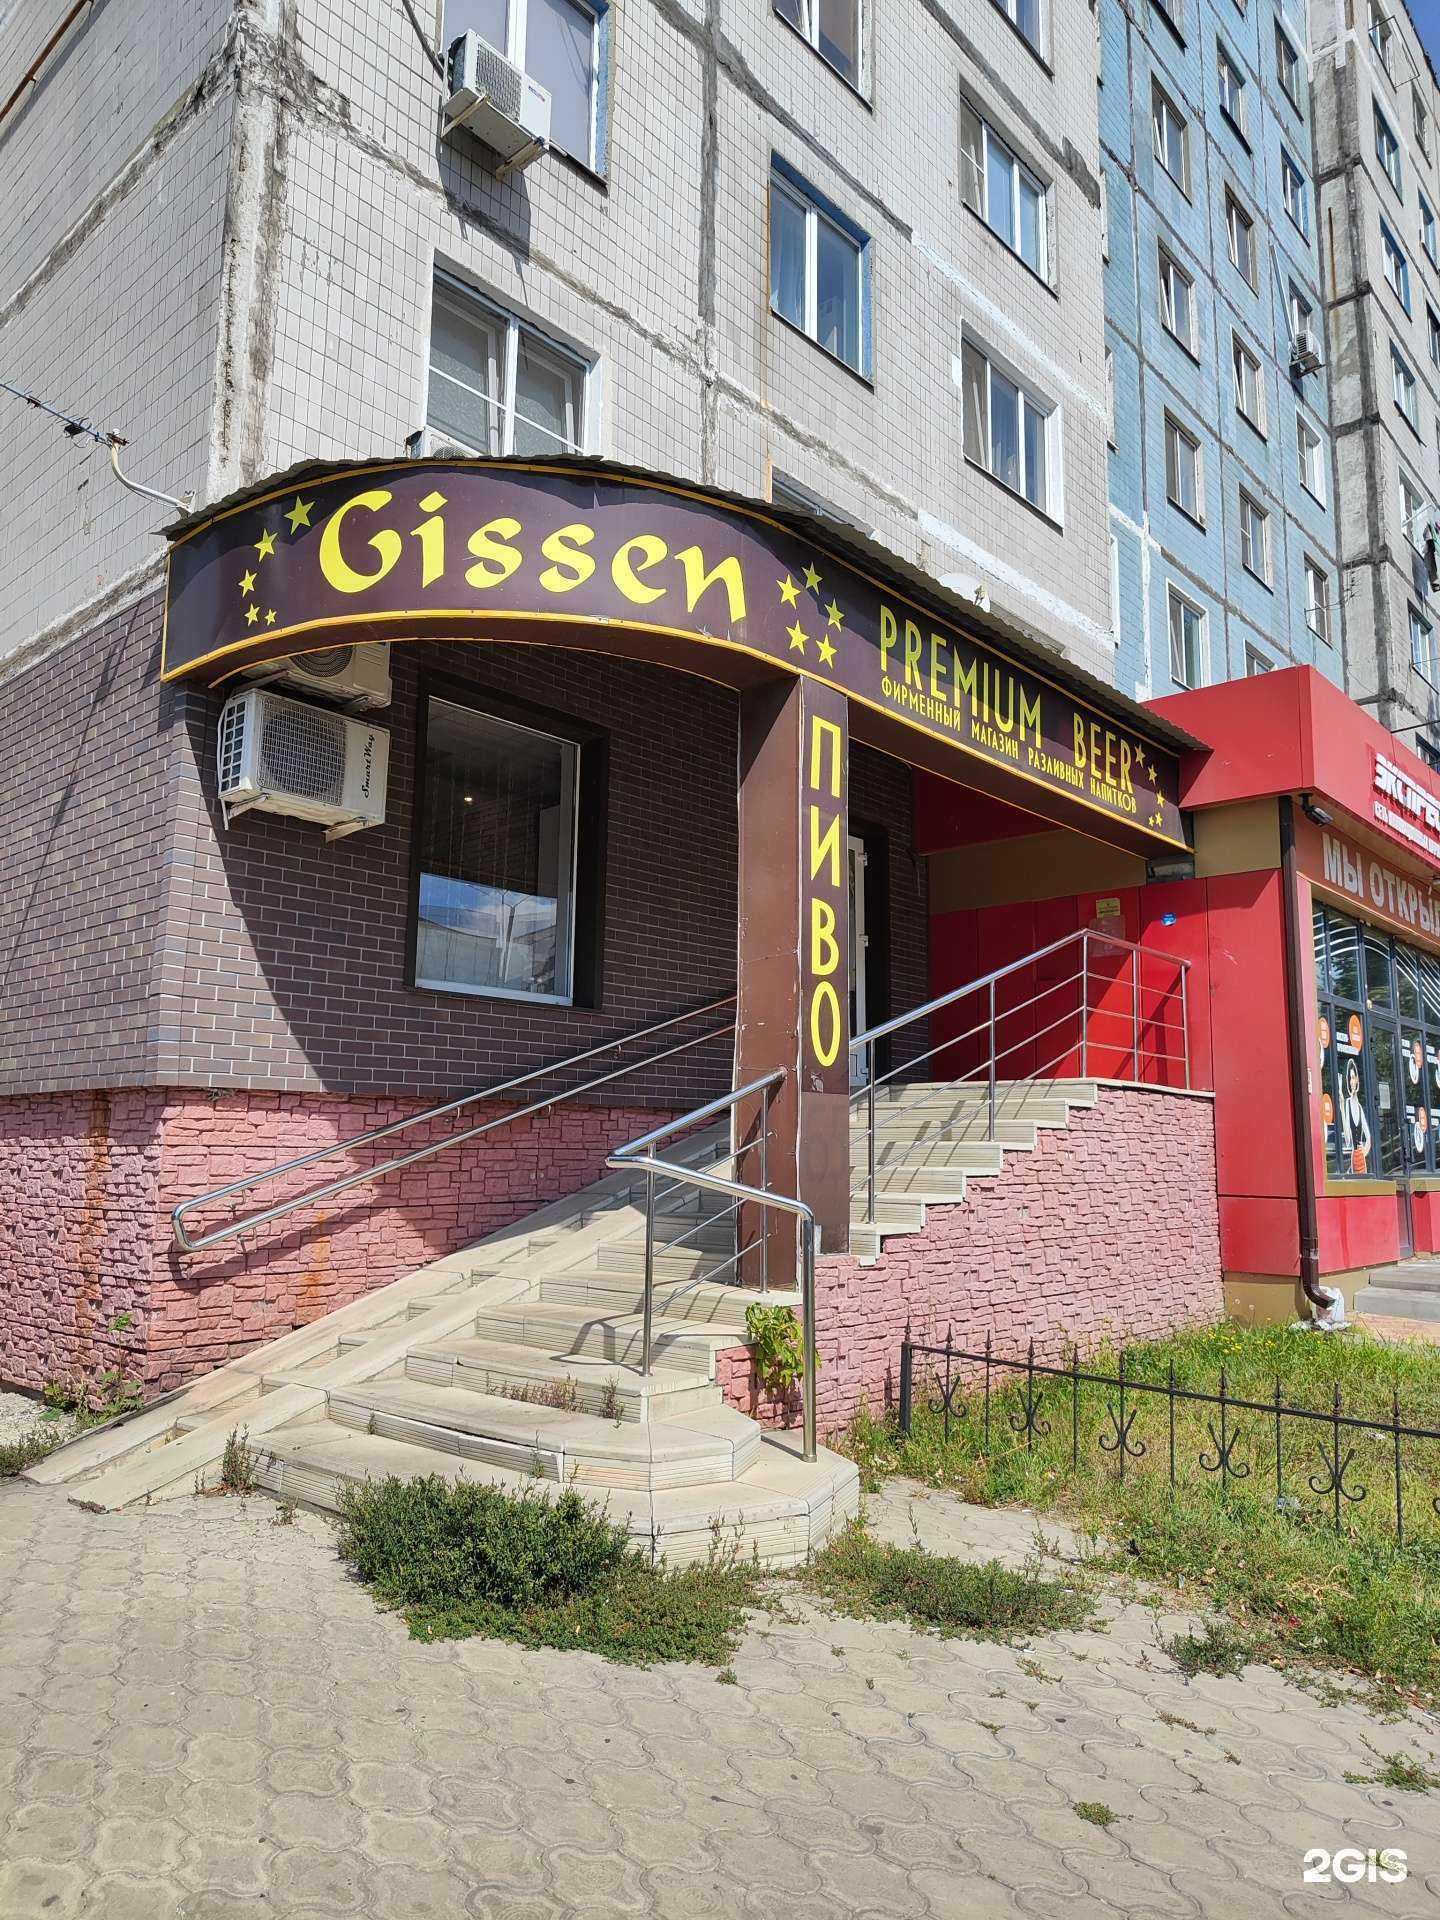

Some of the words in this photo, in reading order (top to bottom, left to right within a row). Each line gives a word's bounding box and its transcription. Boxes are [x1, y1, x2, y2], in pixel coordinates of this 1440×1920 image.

[319, 489, 747, 624] Gissen
[880, 604, 1042, 749] PREMIUM
[1073, 712, 1134, 794] BEER
[881, 675, 961, 732] ФИРМЕННЫЙ
[971, 718, 1019, 760] МАГАЗИН
[1028, 747, 1085, 790] РАЗЛИВНЫХ
[1090, 776, 1137, 814] НАПИТКОВ
[810, 714, 841, 1067] ПИВО
[1322, 831, 1364, 898] МЫ
